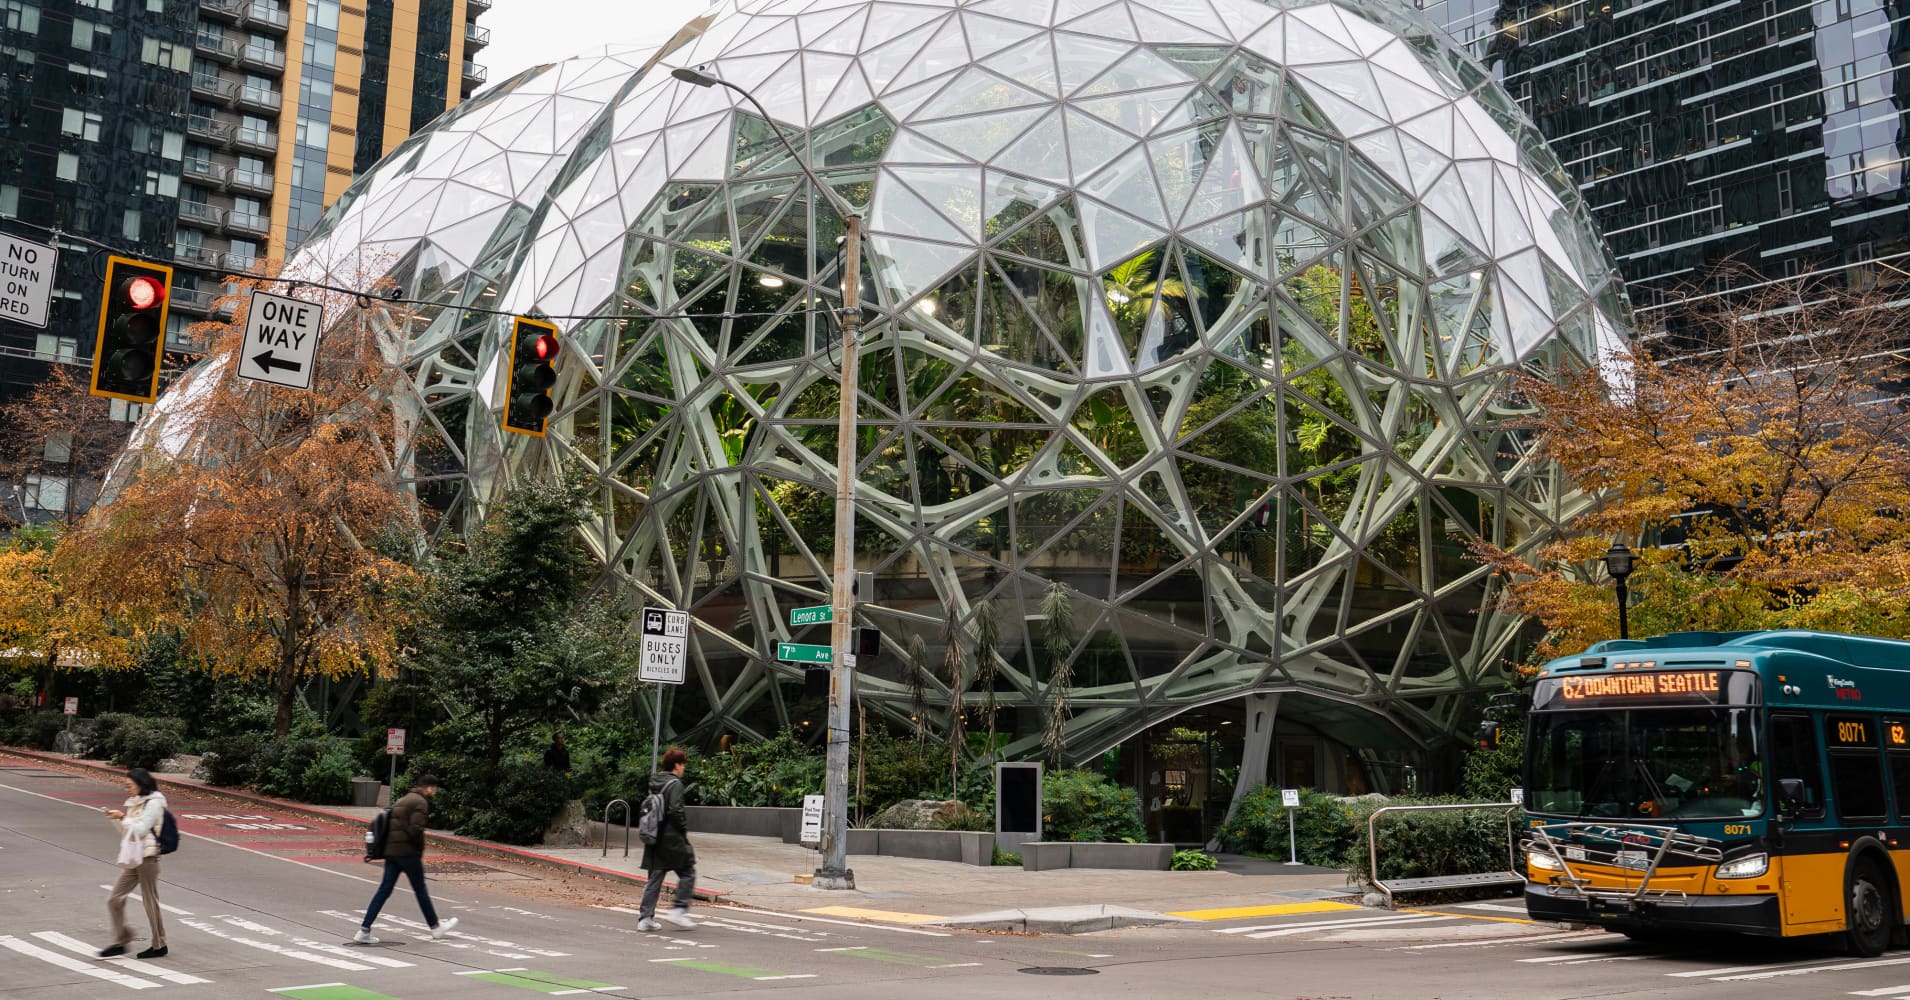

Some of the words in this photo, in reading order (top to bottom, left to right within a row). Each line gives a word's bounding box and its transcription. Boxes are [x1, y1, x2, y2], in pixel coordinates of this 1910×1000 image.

[8, 244, 37, 264] NO
[0, 261, 40, 283] TURN
[7, 281, 27, 297] ON
[0, 298, 29, 315] RED
[262, 301, 309, 328] ONE
[259, 323, 306, 351] WAY
[667, 615, 685, 625] CURB
[793, 611, 816, 623] Lenora
[819, 611, 826, 620] St
[667, 624, 683, 634] LANE
[647, 640, 681, 654] BUSES
[782, 645, 796, 659] 7th
[815, 650, 829, 660] Ave
[650, 653, 677, 665] ONLY
[1562, 676, 1584, 699] 62
[1584, 675, 1655, 696] DOWNTOWN
[1658, 672, 1719, 693] SEATTLE
[1838, 721, 1866, 743] 8071
[1891, 725, 1906, 744] 62
[1724, 824, 1752, 835] 8071
